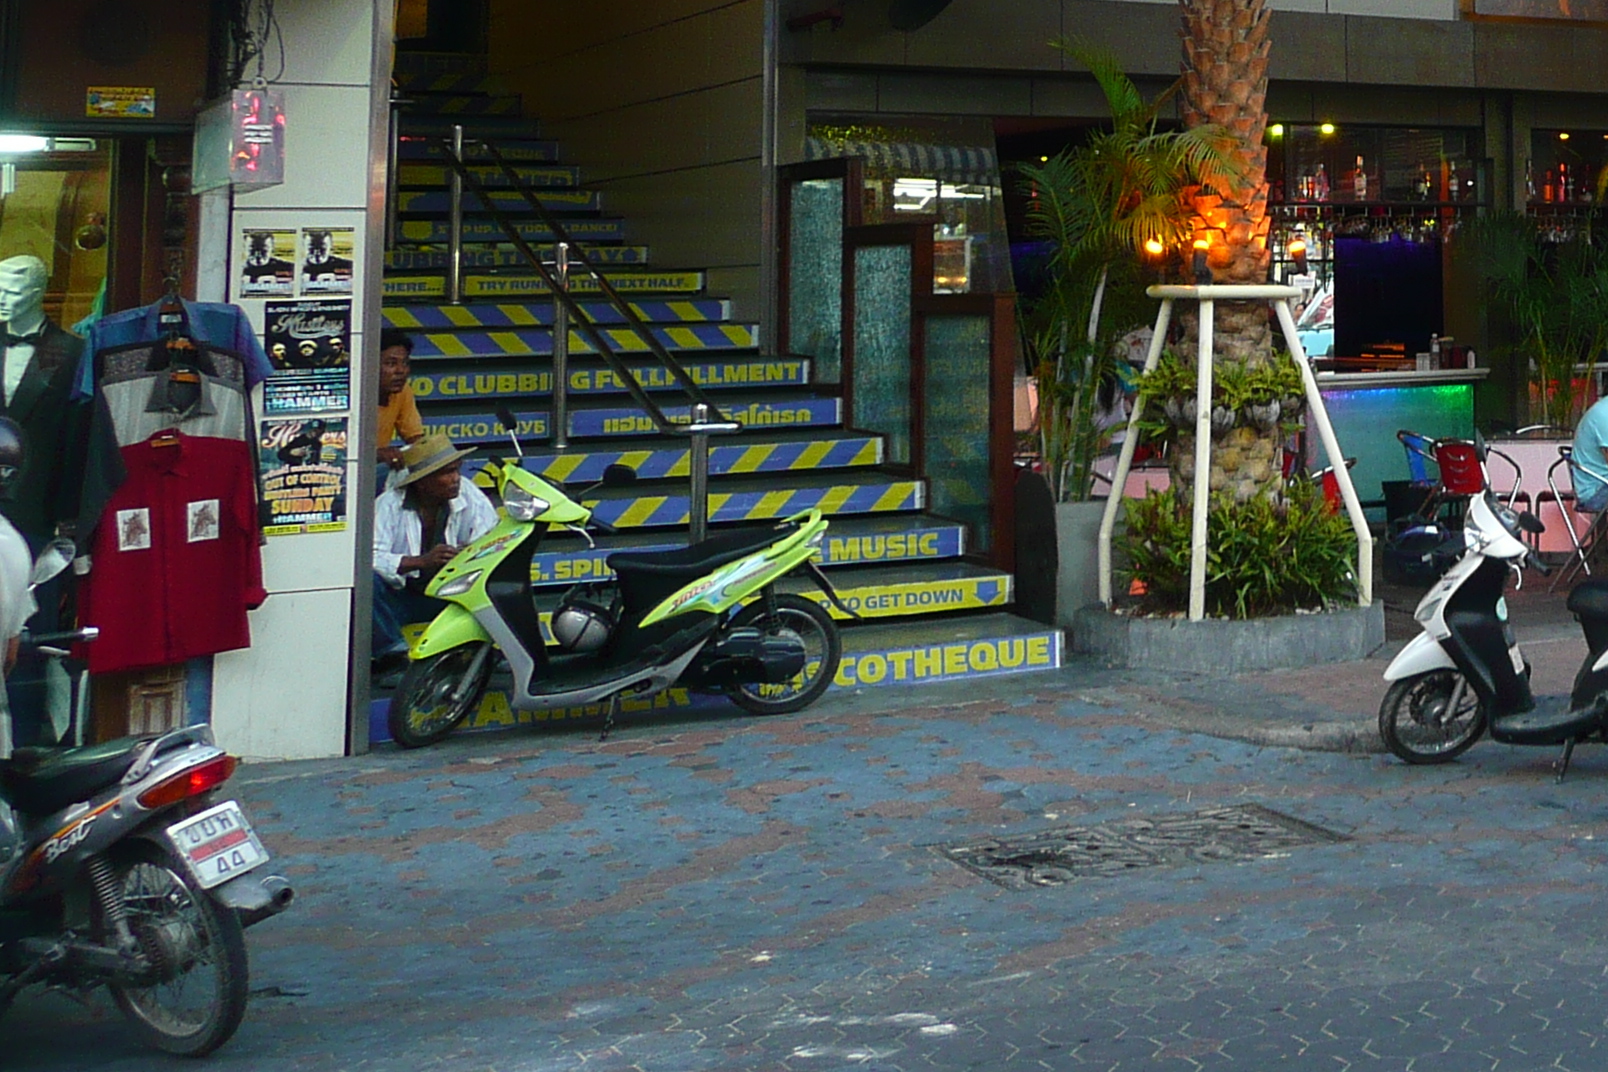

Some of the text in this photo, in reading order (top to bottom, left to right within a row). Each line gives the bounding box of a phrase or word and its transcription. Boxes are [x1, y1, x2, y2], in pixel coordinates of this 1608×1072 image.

[477, 279, 508, 291] TRY
[438, 371, 591, 395] CLUBBIG
[271, 497, 335, 515] SUNDAY
[829, 532, 939, 561] MUSIC
[865, 593, 902, 609] GET
[905, 589, 963, 607] DOWN
[216, 850, 246, 874] 44
